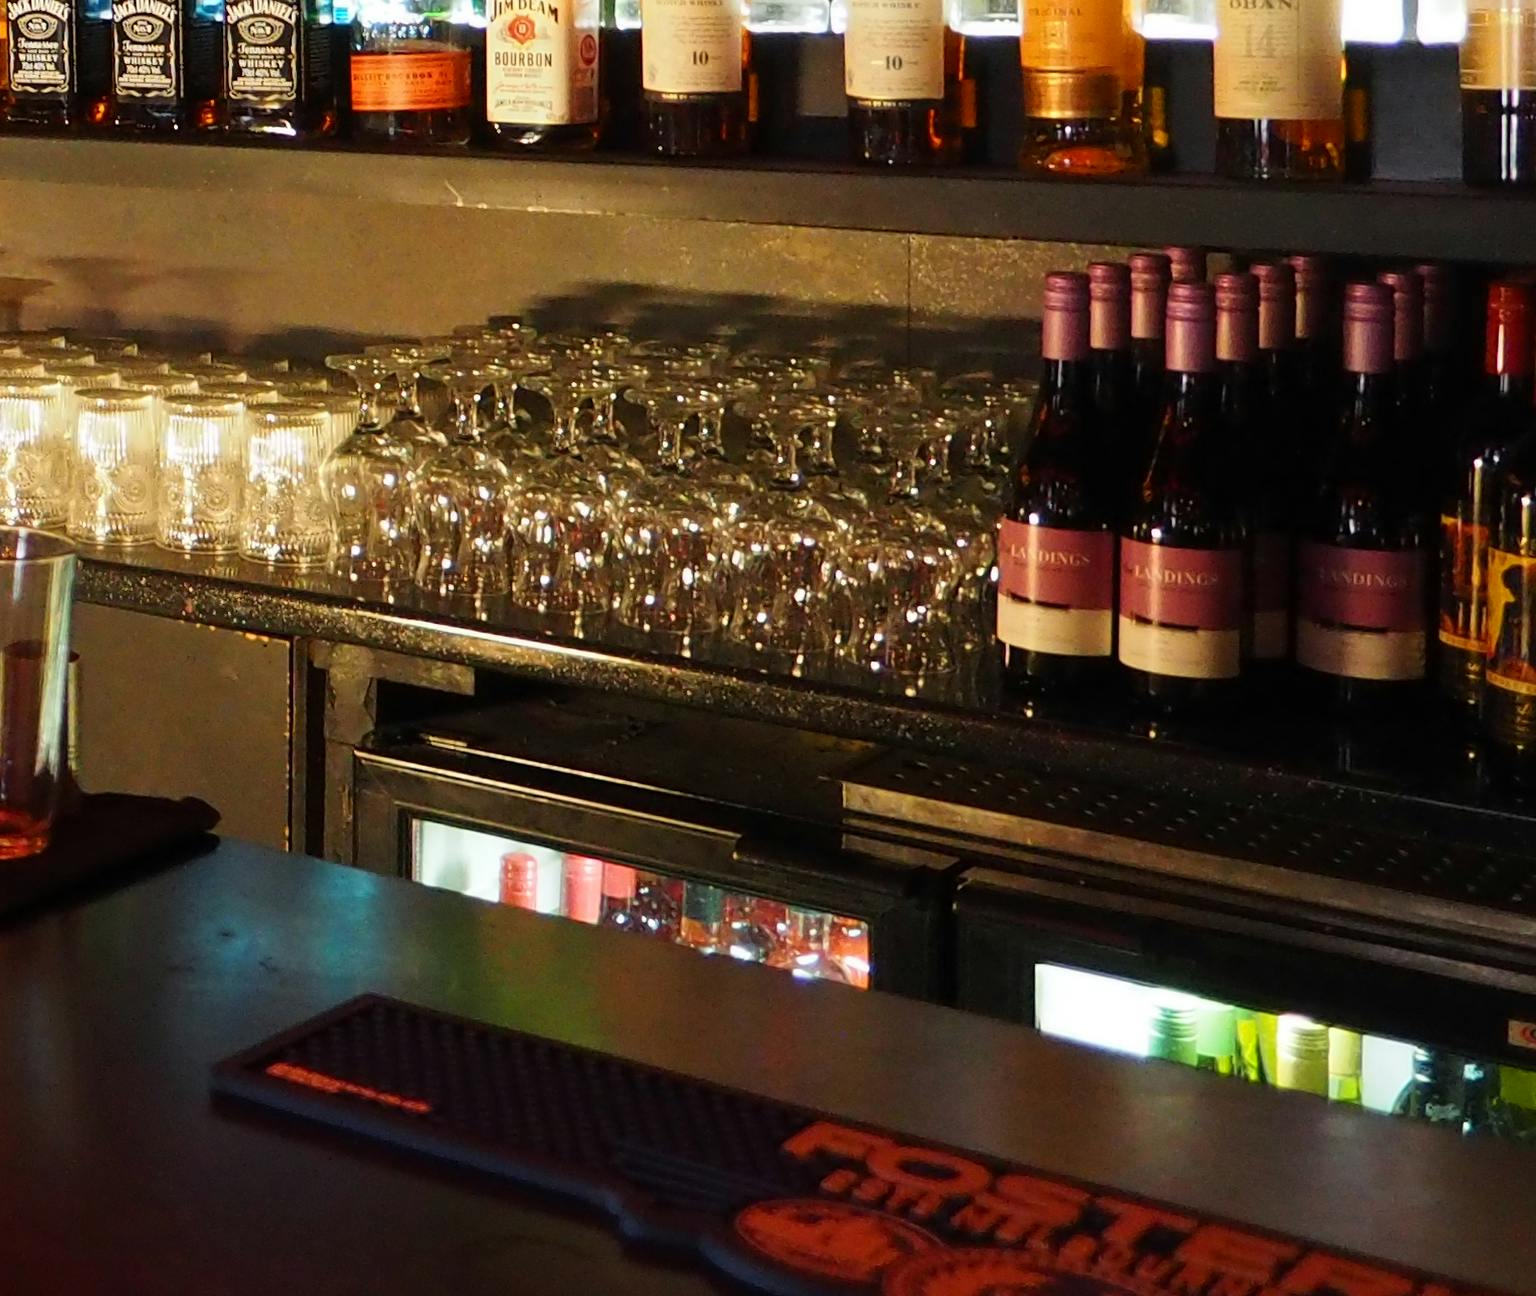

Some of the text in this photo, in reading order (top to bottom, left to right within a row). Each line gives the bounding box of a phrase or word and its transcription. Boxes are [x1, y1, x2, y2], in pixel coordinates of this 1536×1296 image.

[227, 0, 255, 25] JACK
[19, 53, 59, 63] WHISKEY
[123, 56, 165, 66] WHISKEY
[238, 58, 285, 69] WHISKEY
[494, 51, 553, 68] BOURBON
[691, 50, 709, 65] 10
[885, 55, 903, 71] 10
[1009, 543, 1092, 567] LANDINGS
[1134, 564, 1219, 586] LANDINGS
